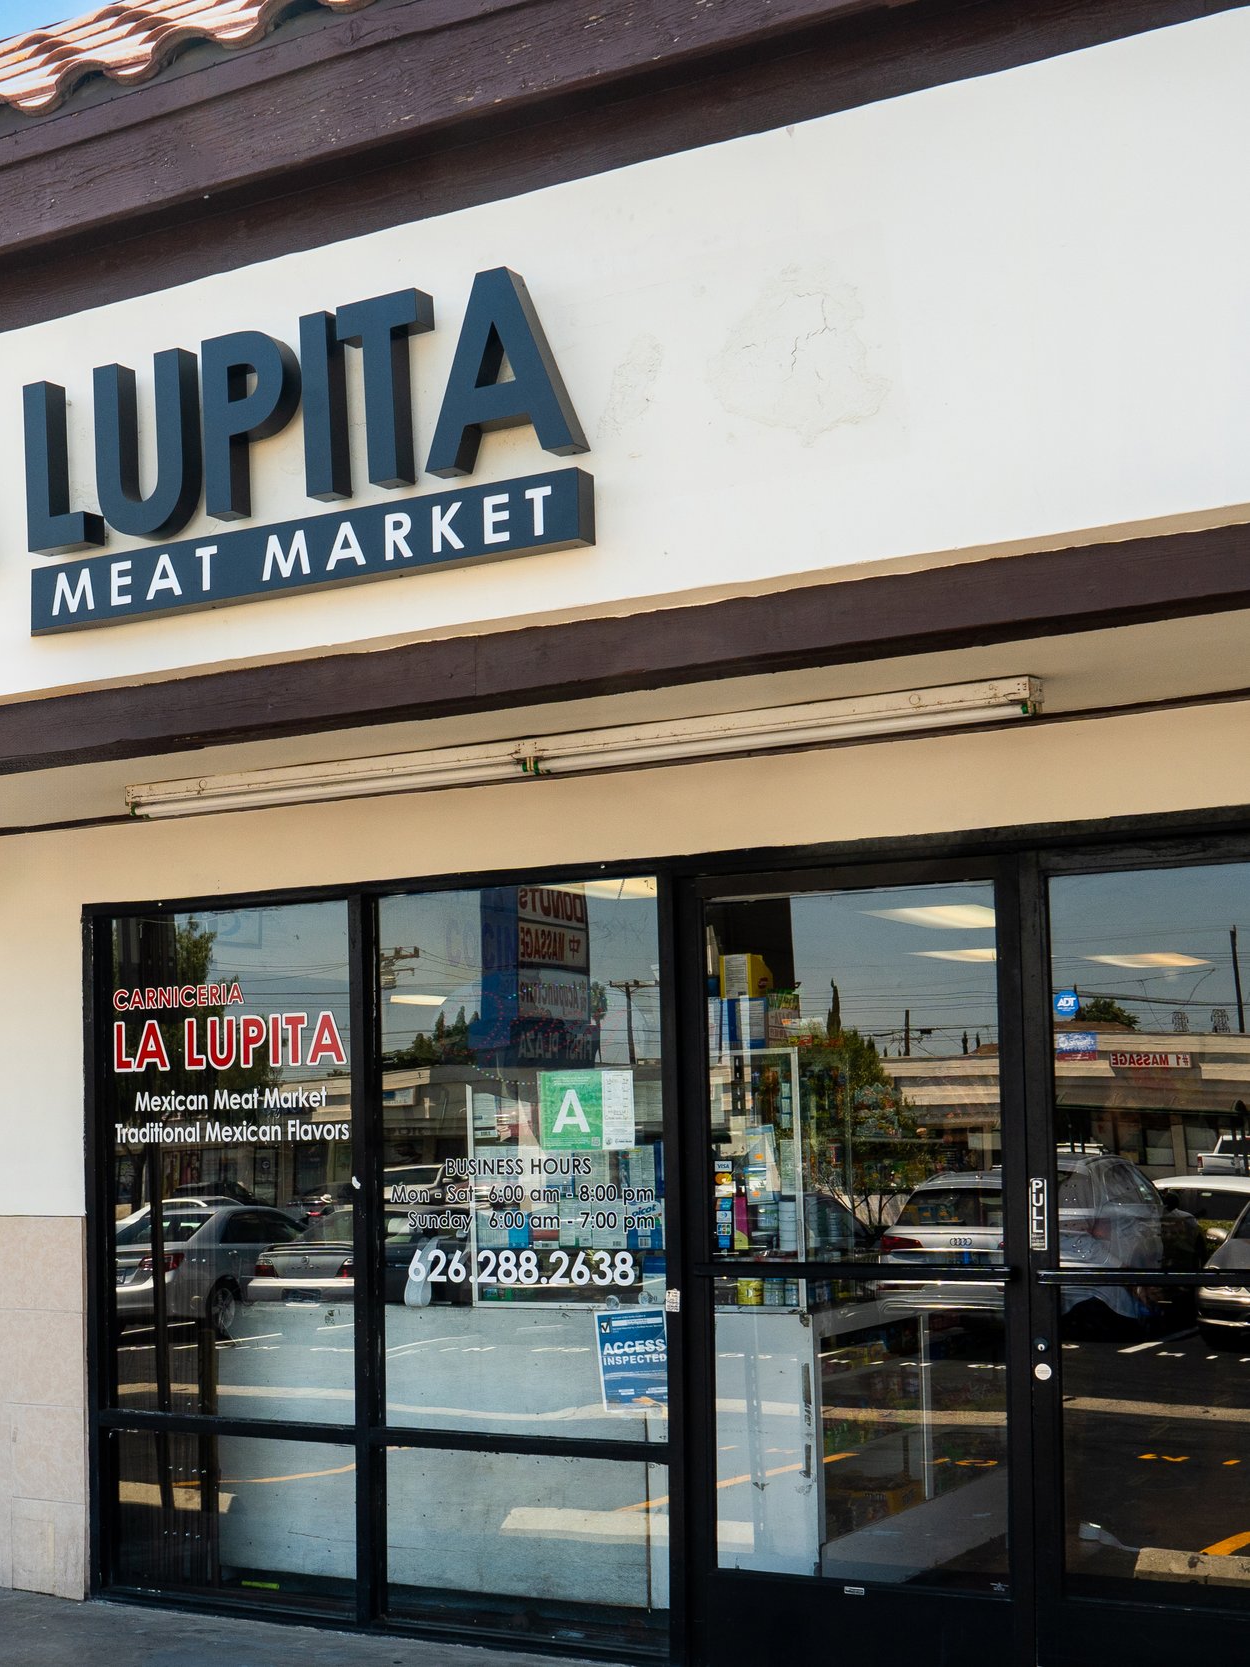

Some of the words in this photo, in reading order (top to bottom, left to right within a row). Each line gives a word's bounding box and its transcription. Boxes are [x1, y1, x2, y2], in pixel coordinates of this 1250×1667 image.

[22, 266, 591, 556] LUPITA
[51, 546, 218, 616] MEAT
[262, 485, 553, 581] MARKET
[113, 983, 245, 1011] CARNICERIA
[1057, 997, 1077, 1007] ADT
[114, 1020, 171, 1073] LA
[185, 1011, 347, 1070] LUPITA
[135, 1090, 209, 1112] Mexican
[214, 1088, 260, 1111] Meat
[264, 1086, 328, 1109] Market
[552, 1089, 591, 1133] A
[115, 1122, 200, 1144] Traditional
[205, 1120, 282, 1143] Mexican
[287, 1119, 350, 1141] Flavors
[445, 1158, 524, 1177] BUSINESS
[530, 1157, 592, 1176] HOURS
[391, 1185, 430, 1203] Mon
[447, 1184, 475, 1202] Sat
[488, 1184, 524, 1202] 6:00
[530, 1188, 560, 1202] am
[579, 1184, 617, 1202] 8:00
[623, 1187, 655, 1206] pm
[1032, 1180, 1044, 1233] PULL
[408, 1211, 473, 1233] Sunday
[488, 1211, 525, 1229] 6:00
[530, 1216, 560, 1229] am
[580, 1211, 617, 1229] 7:00
[623, 1215, 655, 1234] pm
[407, 1248, 635, 1286] 626.288.2638
[603, 1339, 667, 1355] ACCESS
[603, 1353, 667, 1366] INSPECTED
